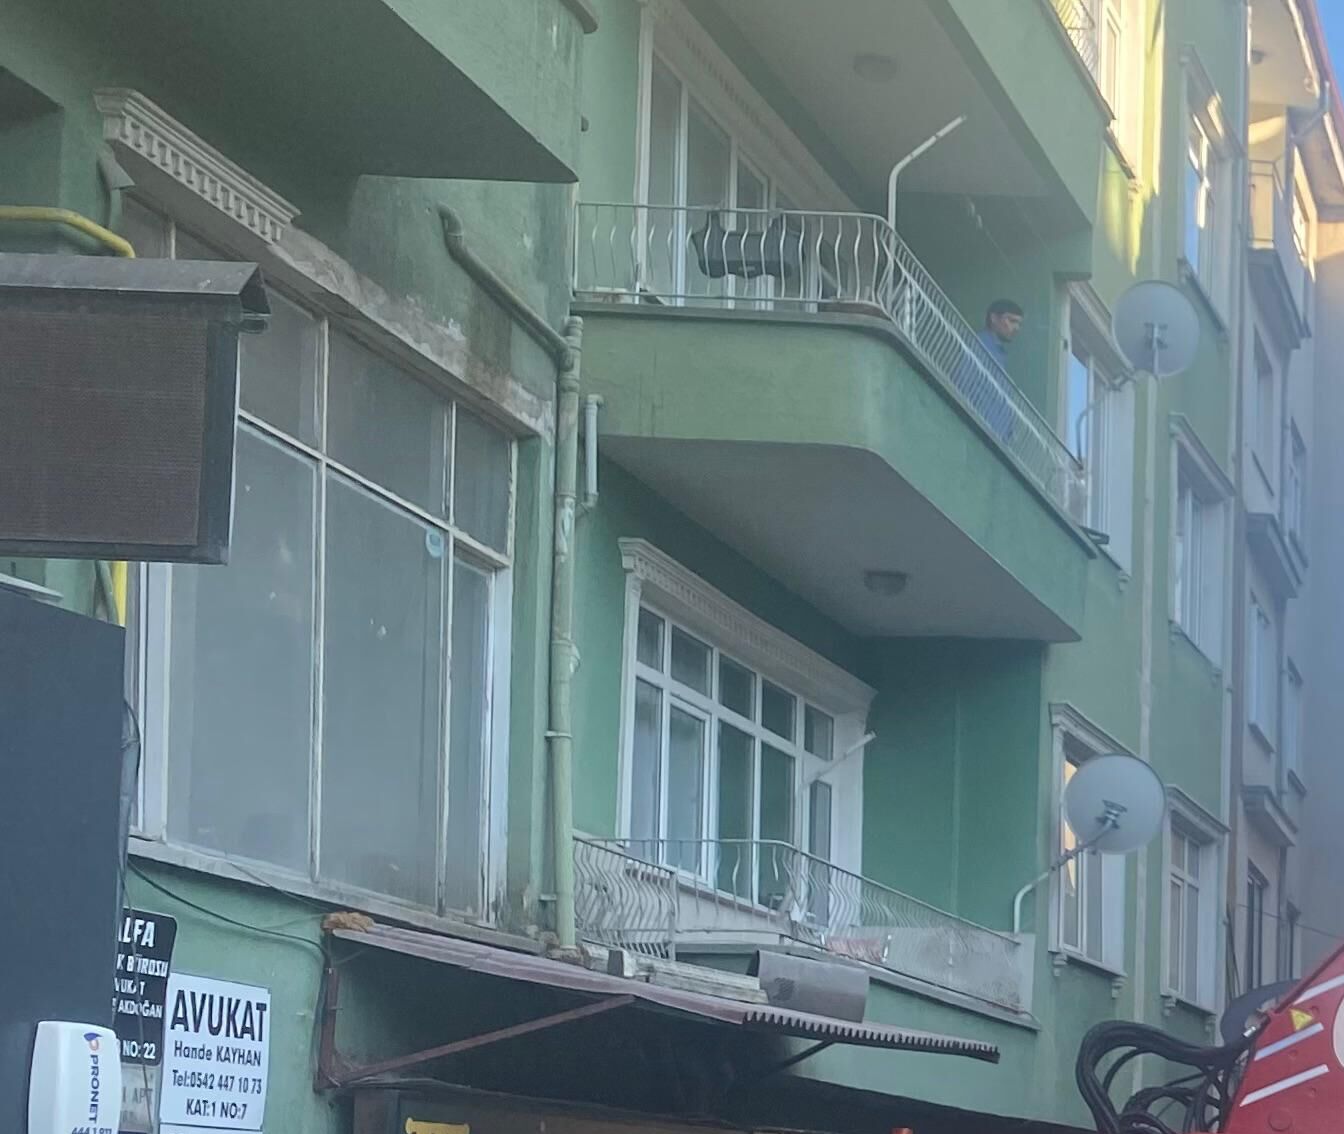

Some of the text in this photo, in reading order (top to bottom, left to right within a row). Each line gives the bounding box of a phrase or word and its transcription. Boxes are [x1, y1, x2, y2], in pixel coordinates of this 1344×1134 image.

[170, 990, 267, 1042] AVUKAT
[174, 1040, 261, 1067] Hande KAYHAN
[89, 1055, 100, 1124] PRONET
[217, 1074, 235, 1091] 447
[238, 1077, 249, 1094] 10
[251, 1078, 262, 1095] 73
[220, 1101, 248, 1119] NO:7
